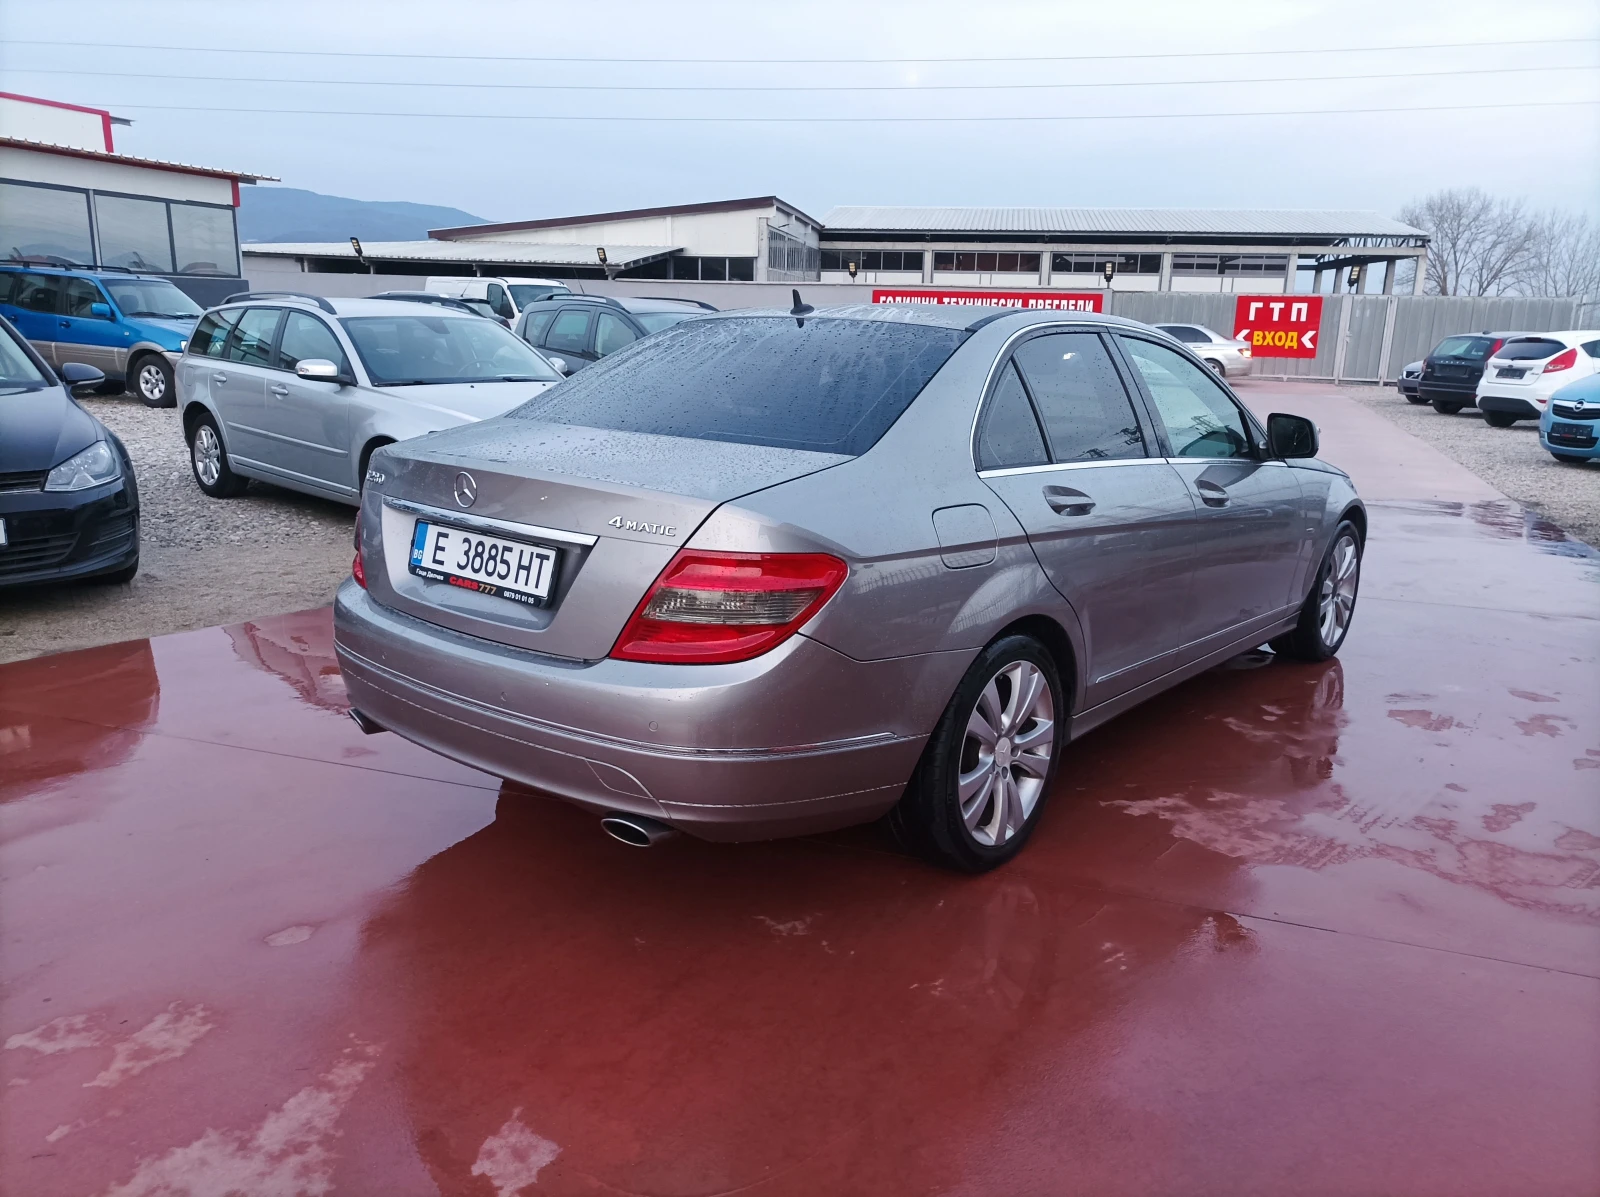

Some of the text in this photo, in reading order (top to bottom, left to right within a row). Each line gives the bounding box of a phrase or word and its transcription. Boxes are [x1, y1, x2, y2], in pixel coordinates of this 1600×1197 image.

[1248, 302, 1308, 322] ГТП
[1252, 330, 1298, 349] ВХОД
[608, 515, 677, 537] 4MATIC
[413, 548, 423, 560] BG
[432, 531, 551, 589] E 3885 HT
[449, 576, 497, 595] CARS777
